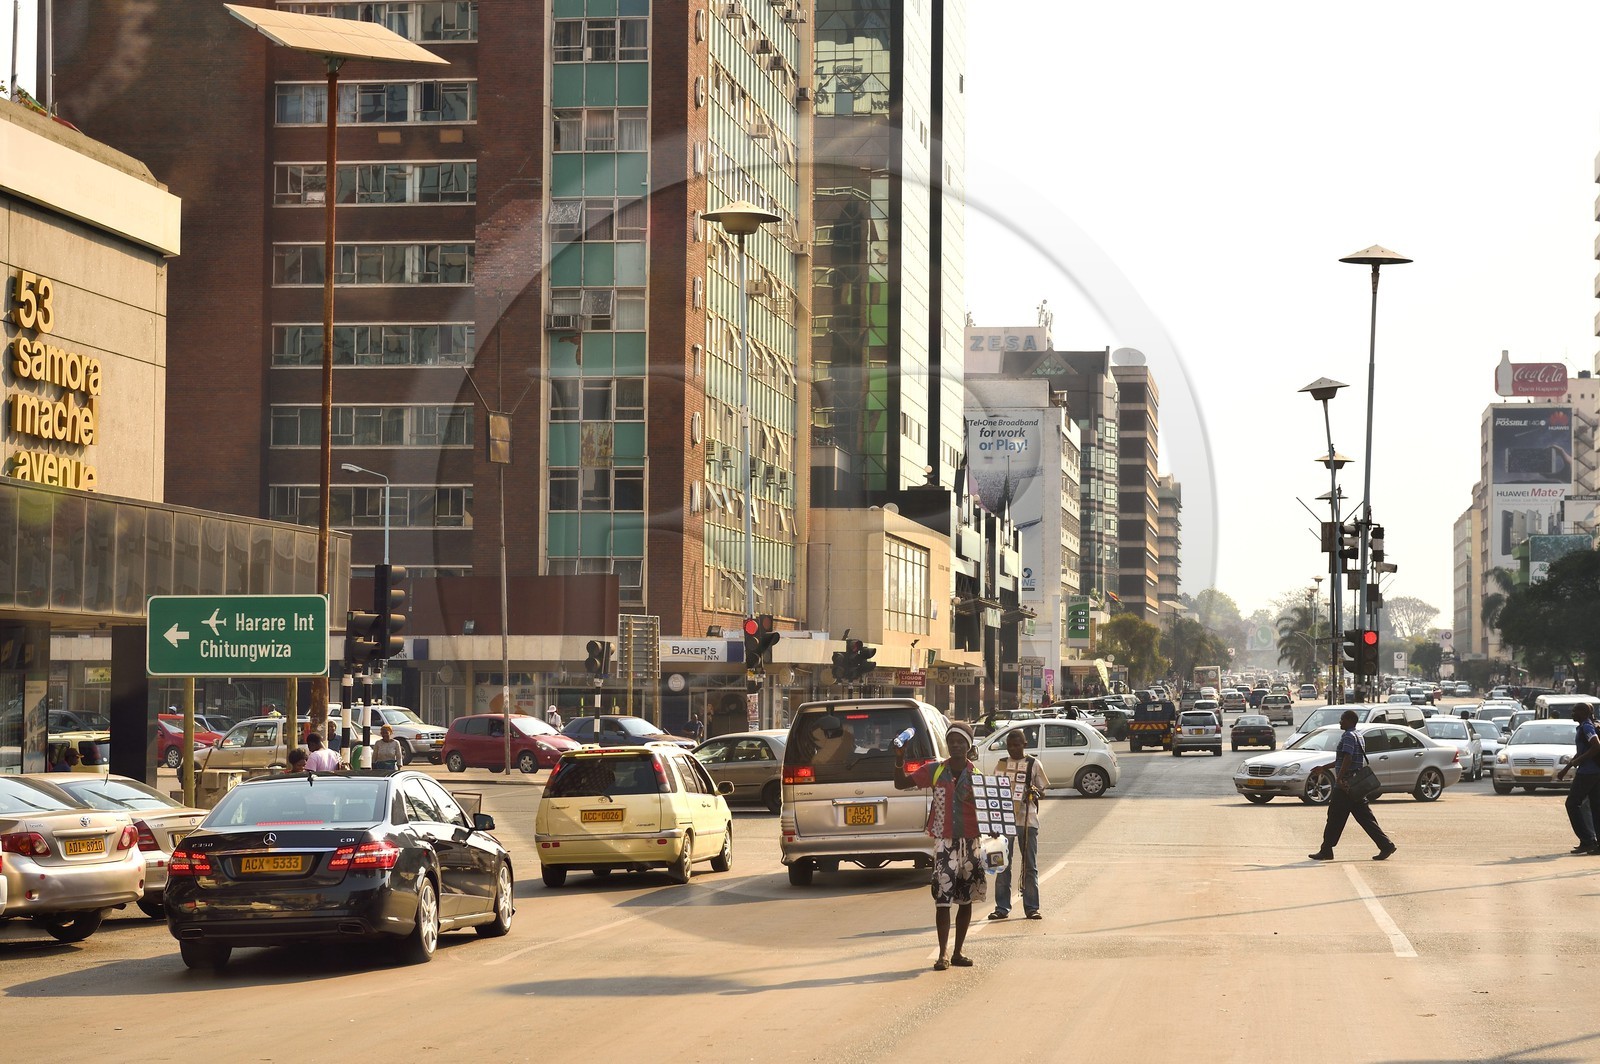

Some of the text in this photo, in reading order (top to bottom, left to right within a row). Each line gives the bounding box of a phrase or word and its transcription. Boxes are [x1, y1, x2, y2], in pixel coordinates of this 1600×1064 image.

[16, 270, 54, 334] 53
[969, 335, 1037, 351] ZESA
[14, 337, 102, 396] samora
[979, 427, 1026, 437] for work
[979, 439, 1028, 453] or Play!
[13, 451, 98, 491] avenue
[235, 612, 314, 631] Harare Int
[200, 639, 292, 662] Chitungwiza
[671, 646, 717, 655] BAKER'S
[583, 811, 619, 821] ACC 0026
[854, 807, 871, 816] ACH
[851, 815, 872, 825] 8567
[86, 840, 104, 852] 8910
[244, 856, 300, 870] ACX 5333
